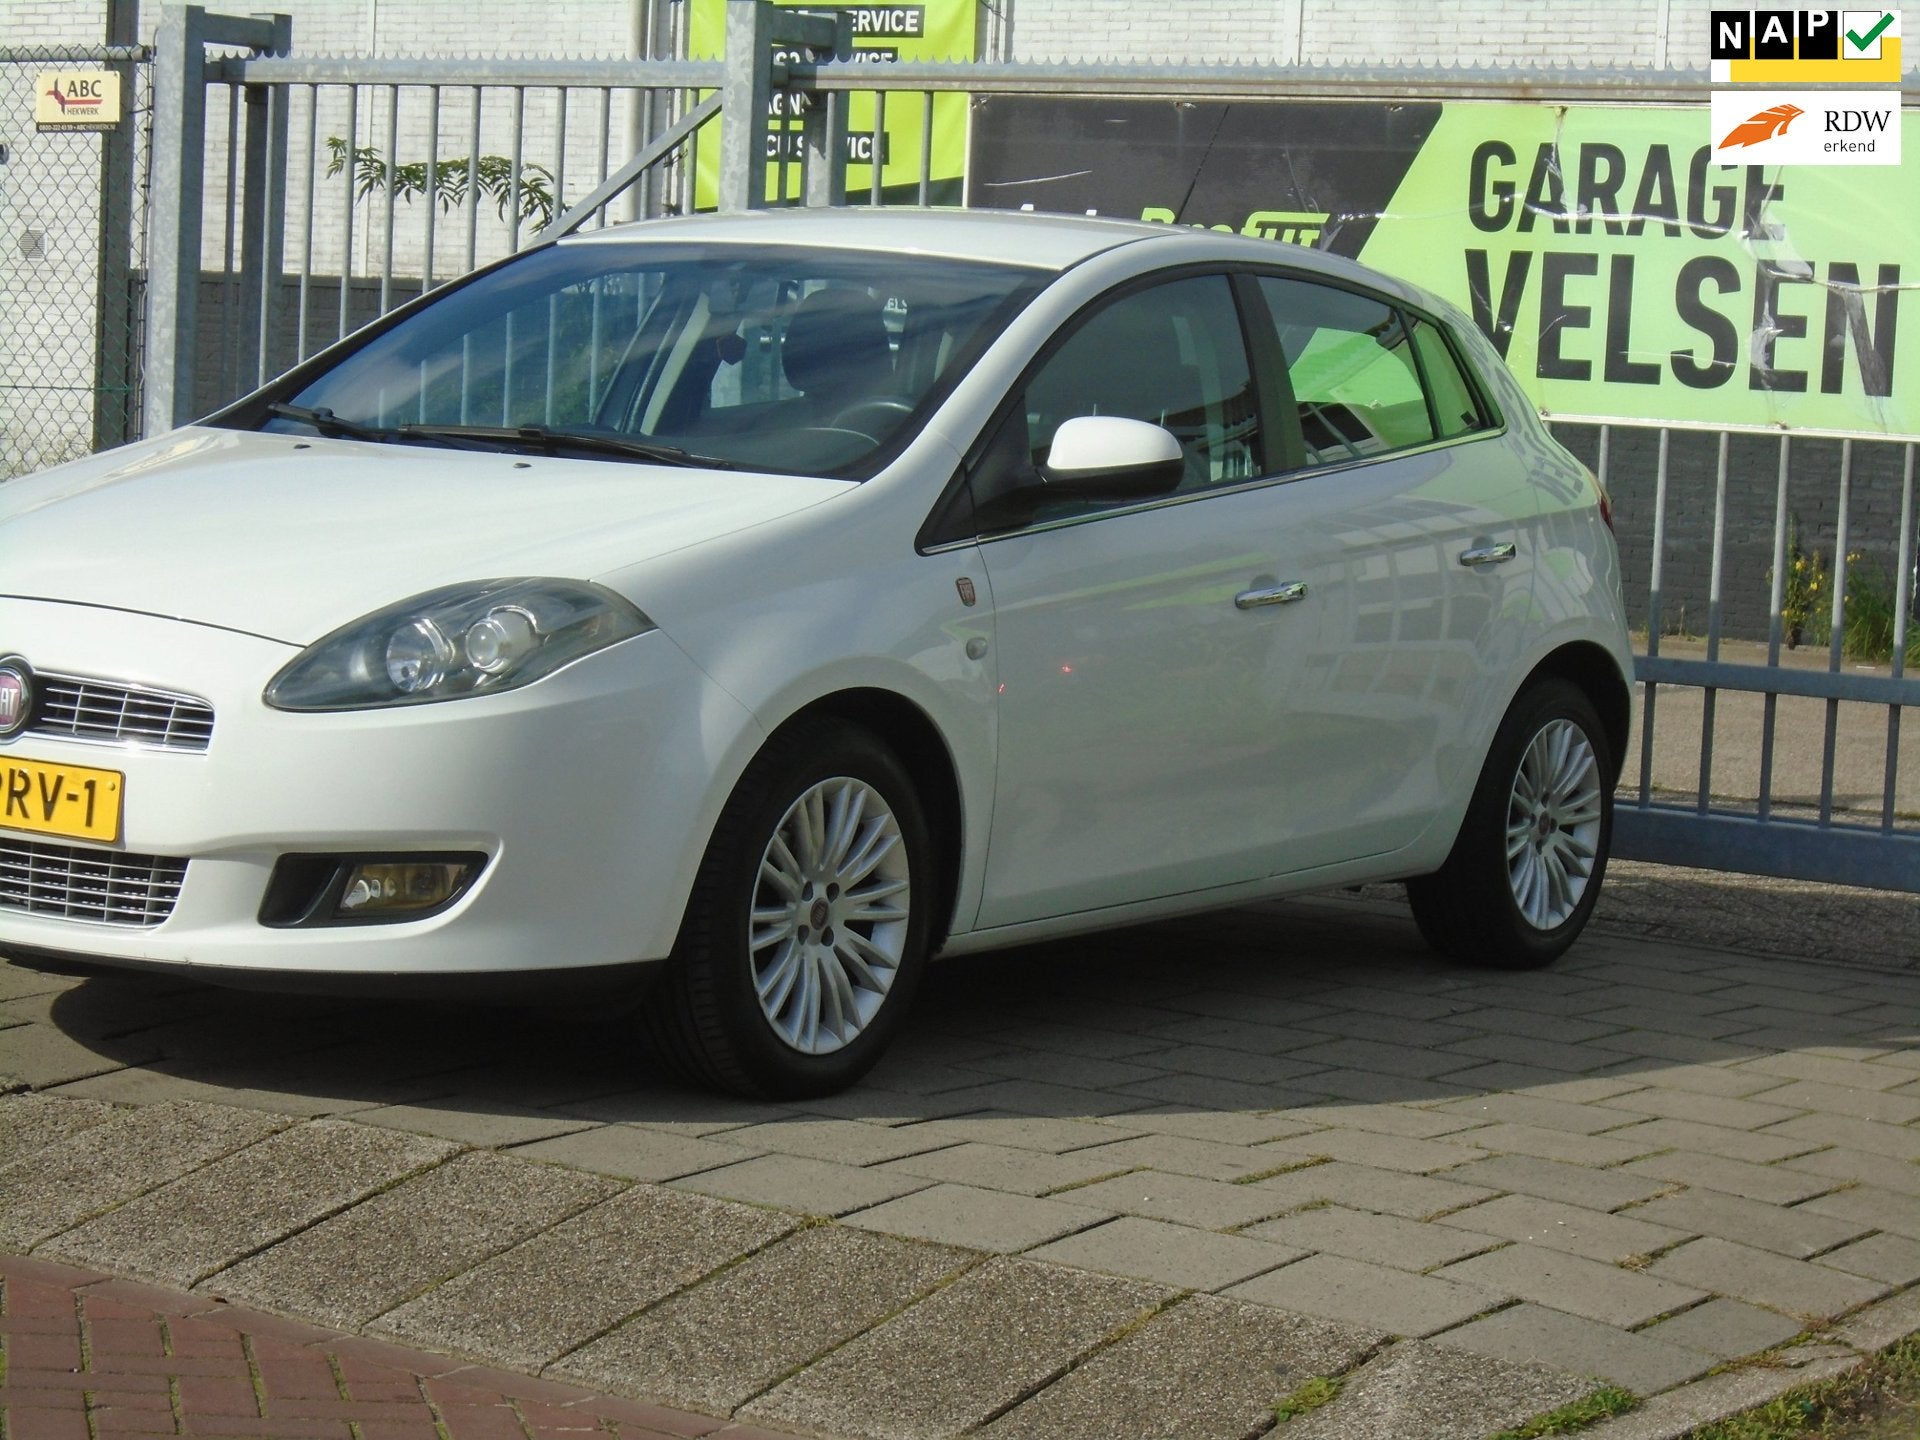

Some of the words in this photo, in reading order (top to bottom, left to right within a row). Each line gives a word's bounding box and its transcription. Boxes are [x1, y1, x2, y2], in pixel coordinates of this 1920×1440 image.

[852, 10, 919, 32] RVICE
[67, 80, 102, 97] ABC
[67, 107, 99, 115] HEKWERK
[1468, 140, 1785, 240] GARAGE
[1465, 249, 1900, 397] VELSEN
[0, 768, 97, 828] RV-1
